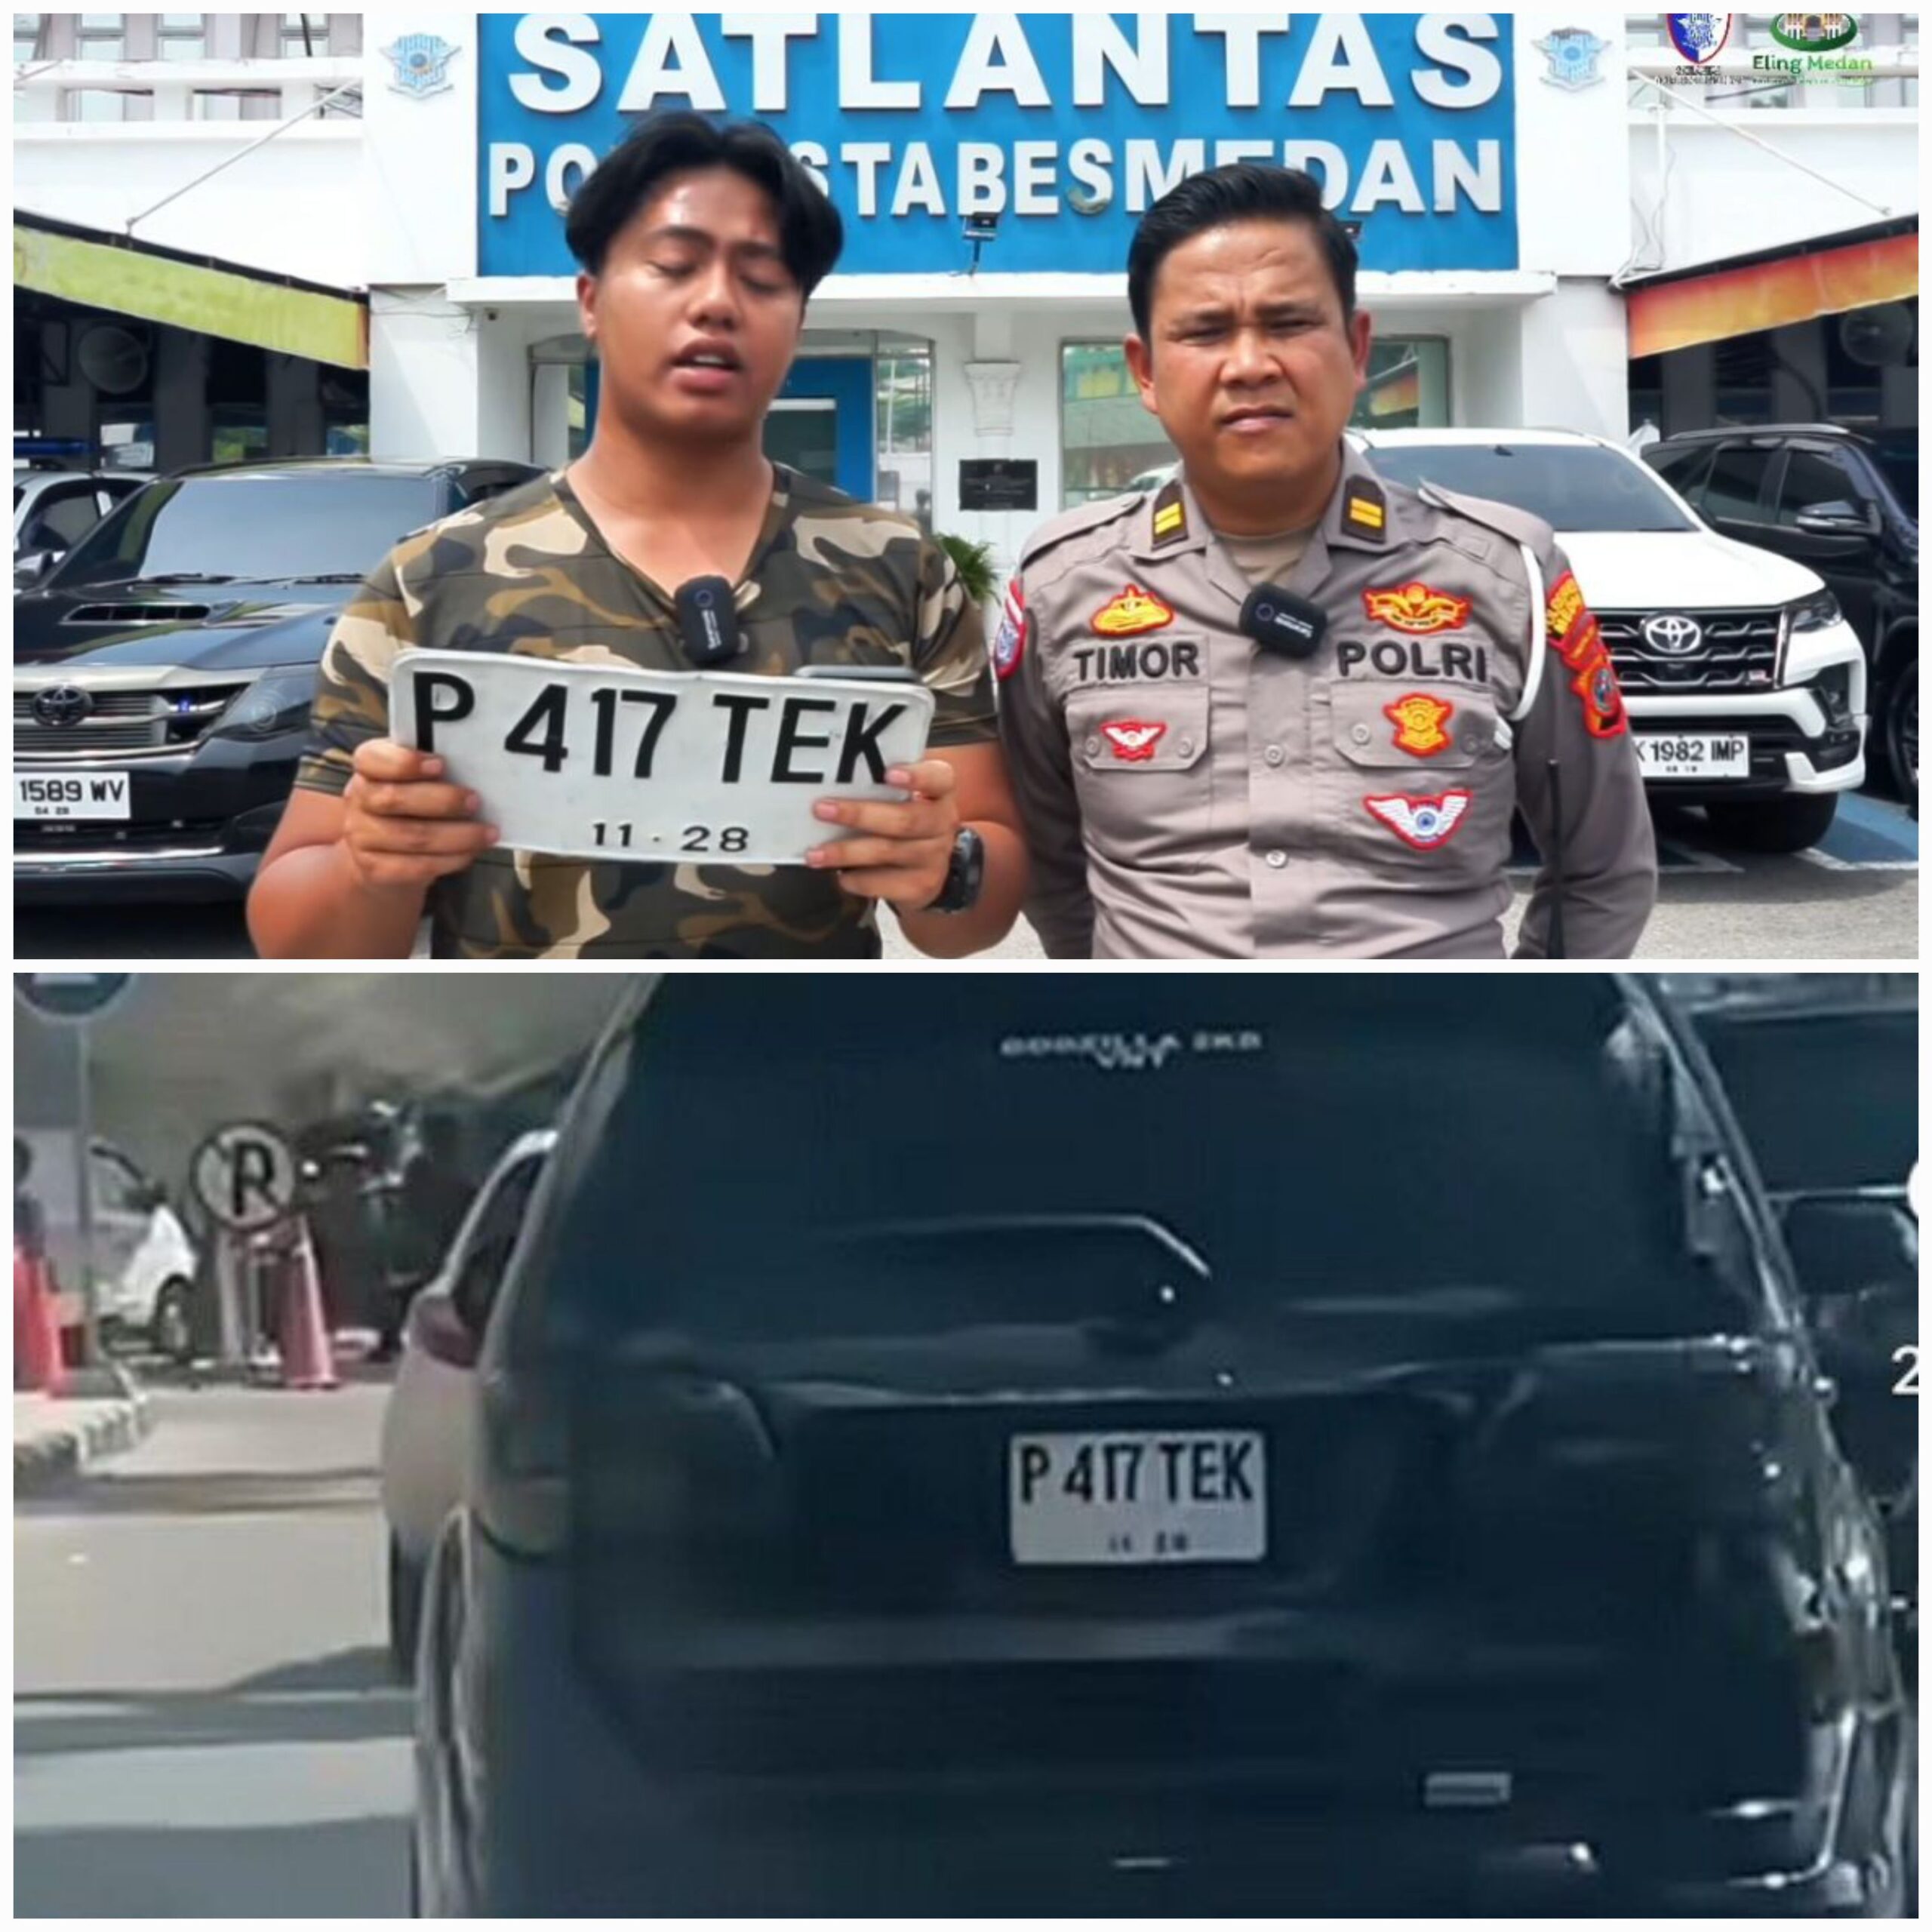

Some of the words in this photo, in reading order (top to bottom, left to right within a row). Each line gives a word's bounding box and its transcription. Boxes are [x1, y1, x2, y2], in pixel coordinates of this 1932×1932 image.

[507, 14, 1503, 112] SATLANTAS
[1073, 641, 1199, 680] TIMOR
[1337, 640, 1487, 682] POLRI
[412, 672, 475, 753] P
[504, 684, 677, 779] 417
[713, 695, 909, 785] TEK
[1650, 740, 1704, 761] 1982
[1711, 740, 1745, 761] IMP
[20, 780, 82, 801] 1589
[91, 780, 125, 801] WV
[592, 823, 632, 848] 11
[681, 826, 749, 853] 28
[1020, 1444, 1050, 1504] P
[1063, 1442, 1145, 1503] 417
[1158, 1440, 1254, 1502] TEK
